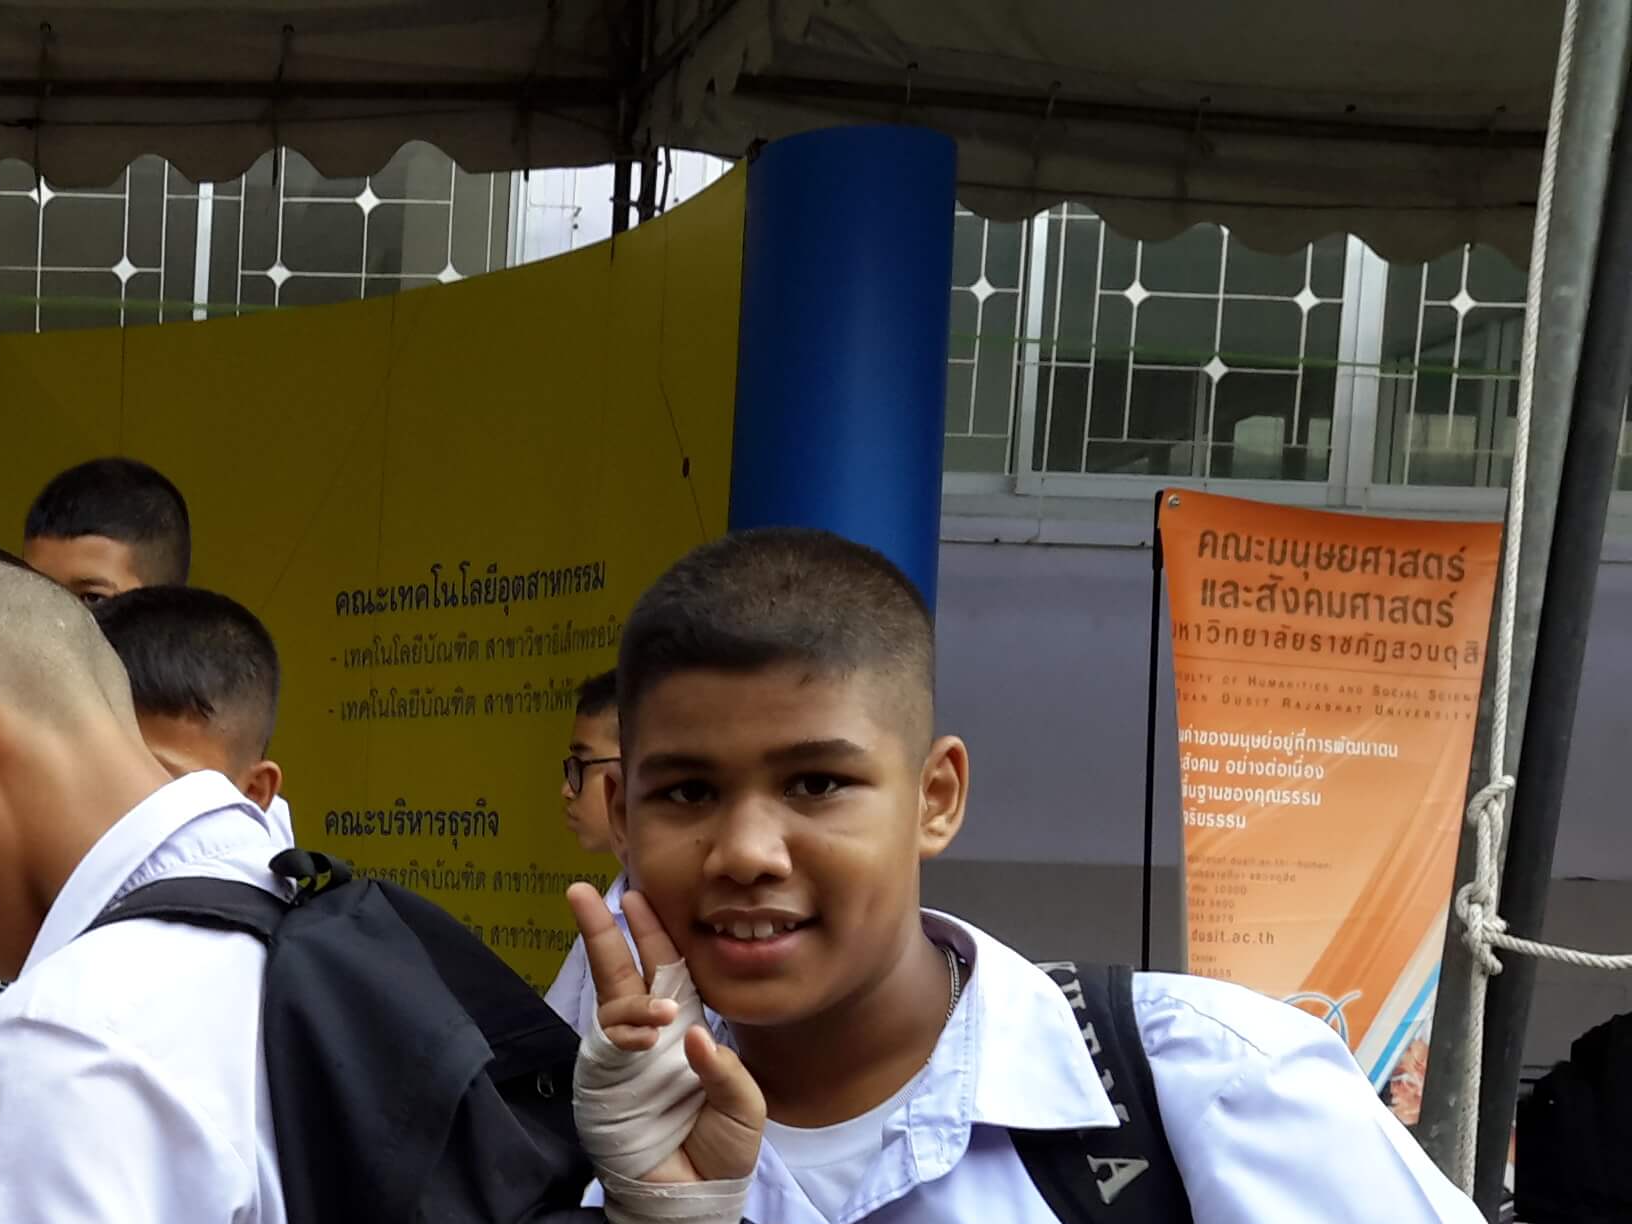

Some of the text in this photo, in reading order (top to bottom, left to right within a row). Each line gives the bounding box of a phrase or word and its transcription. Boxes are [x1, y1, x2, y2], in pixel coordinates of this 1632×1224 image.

[1197, 528, 1467, 583] คณะมนุษยศาสตร์
[335, 560, 606, 616] คณะเทคโนโลยีอุตสาหกรรม
[1200, 574, 1458, 629] และสังคมศาสตร์
[1180, 752, 1219, 774] สังคม
[325, 798, 500, 850] คณะบริหารธุรกิจ
